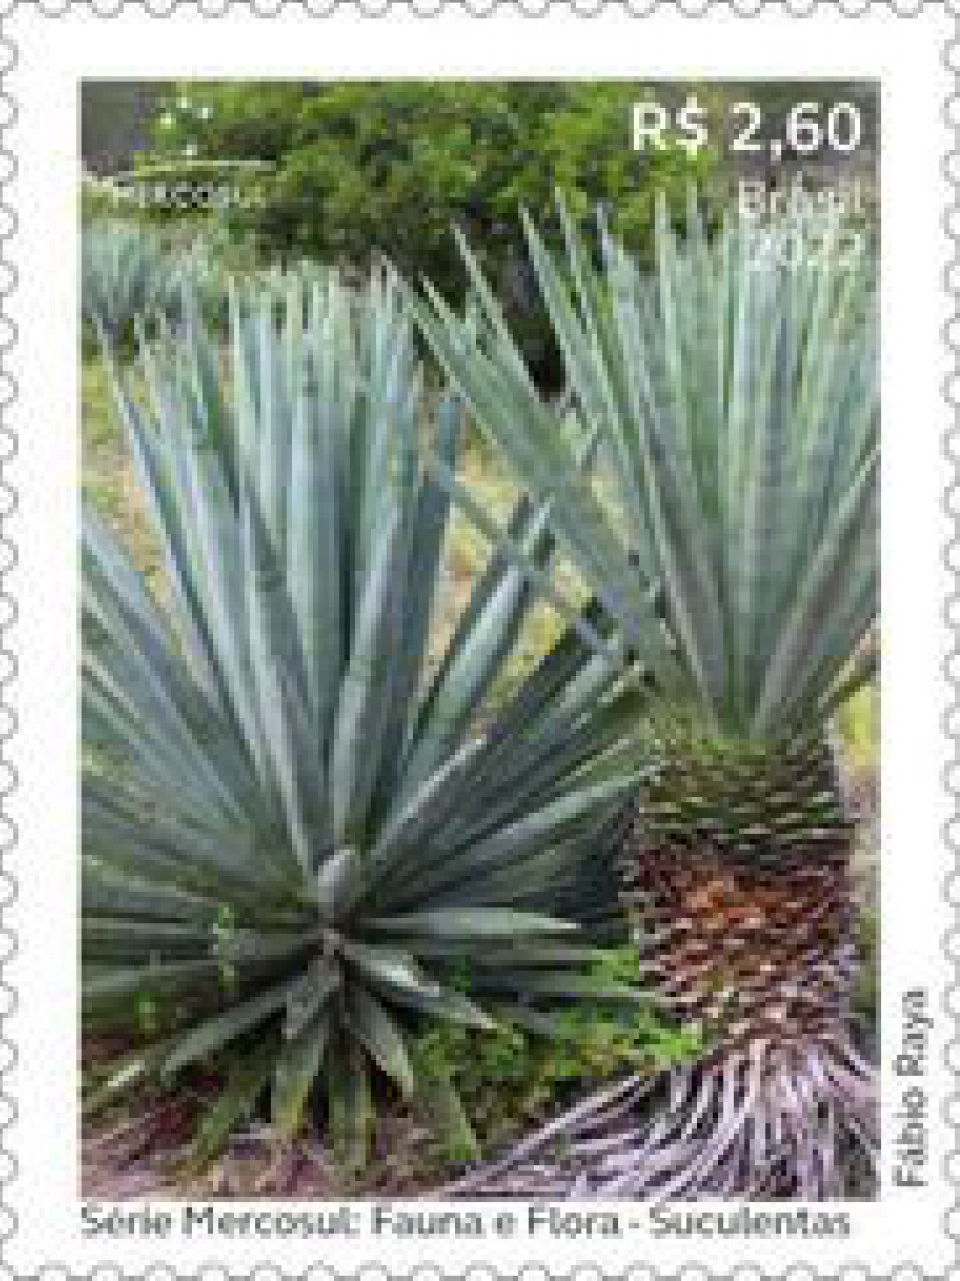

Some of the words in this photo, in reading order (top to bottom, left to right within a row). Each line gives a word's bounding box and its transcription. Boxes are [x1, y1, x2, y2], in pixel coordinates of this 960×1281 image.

[630, 95, 708, 160] R$
[729, 101, 863, 162] 2,60
[893, 987, 934, 1076] Raya
[893, 1088, 926, 1186] Fábio
[79, 1208, 172, 1238] Série
[183, 1208, 358, 1238] Mercosul:
[372, 1208, 484, 1238] Fauna
[494, 1216, 516, 1238] e
[526, 1208, 620, 1238] Flora
[648, 1208, 852, 1238] Suculentas
